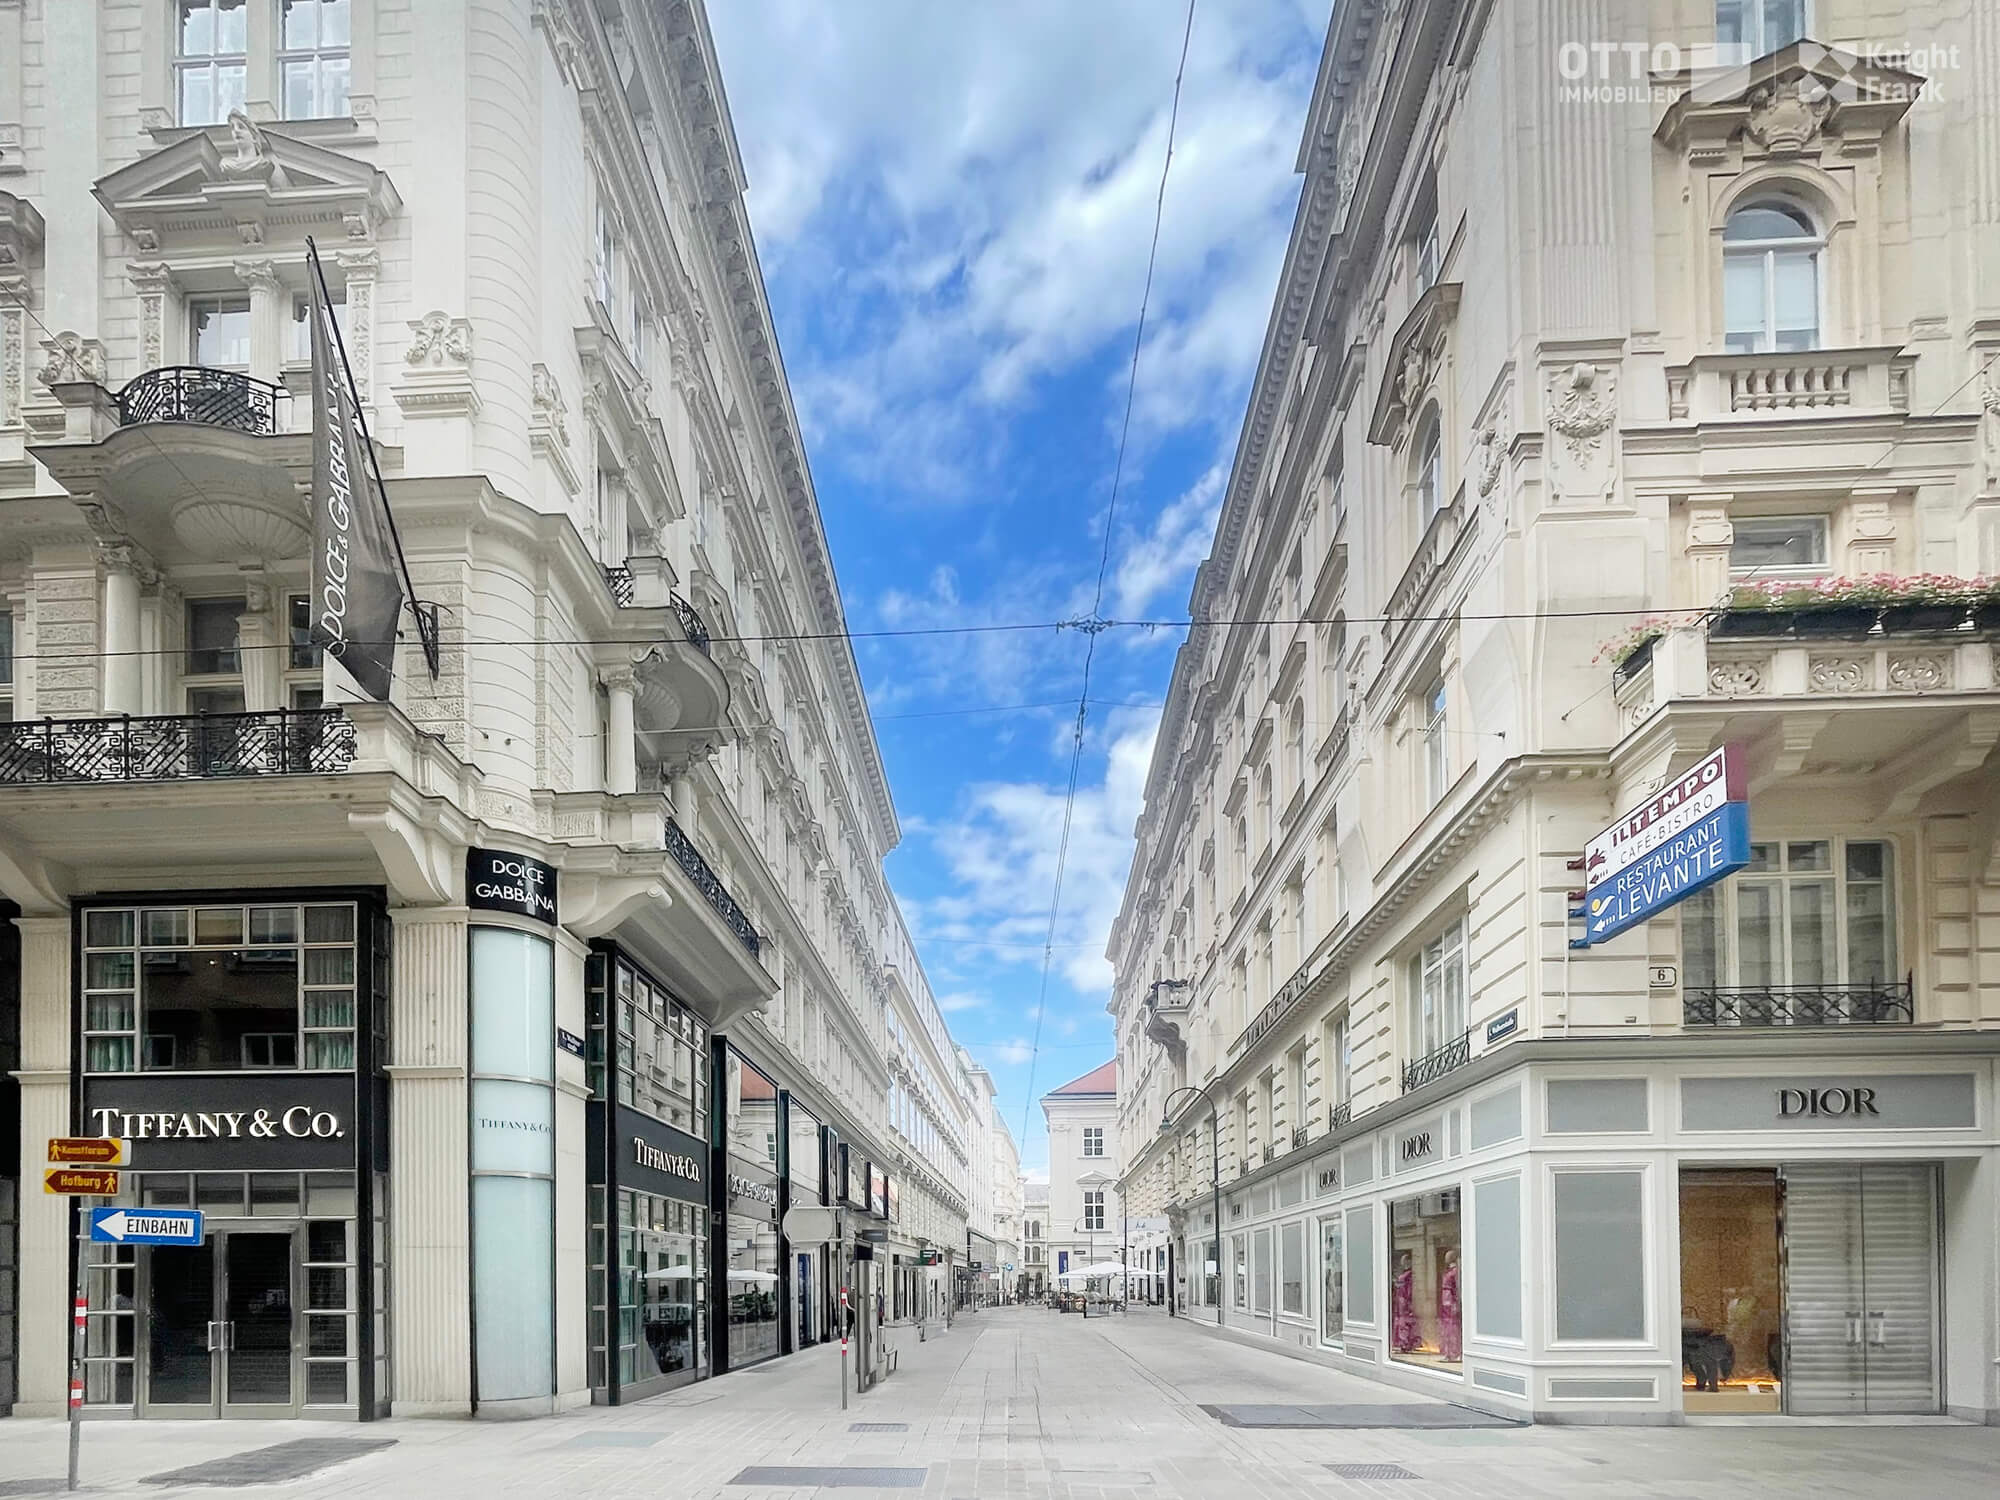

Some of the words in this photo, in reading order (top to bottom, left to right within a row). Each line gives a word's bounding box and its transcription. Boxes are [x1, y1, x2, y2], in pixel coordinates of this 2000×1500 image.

[321, 538, 348, 641] DOLCE
[337, 534, 348, 550] &
[1612, 826, 1630, 848] IL
[1631, 763, 1719, 833] TEMPO
[1617, 816, 1721, 894] RESTAURANT
[492, 860, 544, 885] DOLCE
[516, 879, 524, 887] &
[1618, 839, 1724, 920] LEVANTE
[475, 883, 554, 912] GABBANA
[1657, 969, 1666, 981] 6
[1776, 1088, 1880, 1117] DIOR
[1402, 1131, 1432, 1160] DIOR
[60, 1175, 100, 1189] Hofburg
[127, 1219, 188, 1235] EINBAHN
